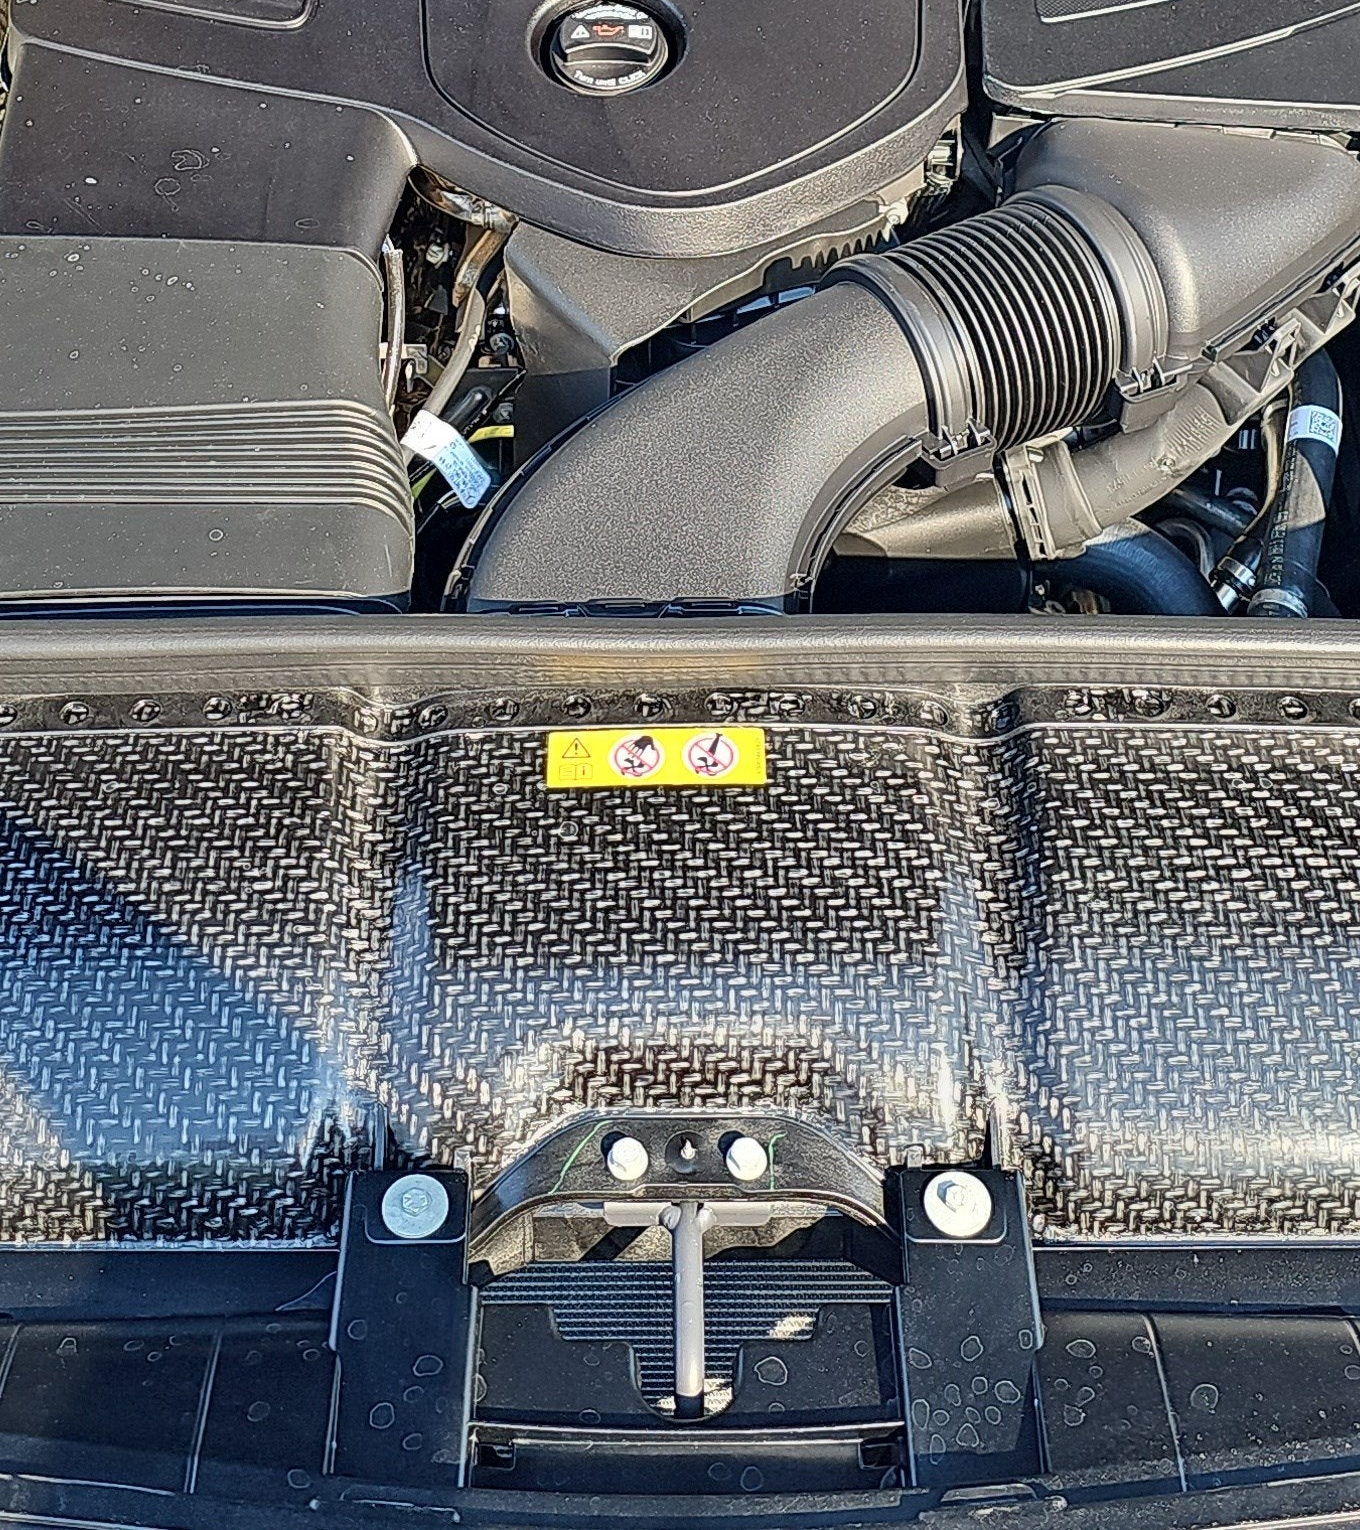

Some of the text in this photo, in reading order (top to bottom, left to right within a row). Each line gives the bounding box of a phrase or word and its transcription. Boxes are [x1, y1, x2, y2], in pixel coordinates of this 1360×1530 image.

[574, 69, 646, 86] Turn until CLICK
